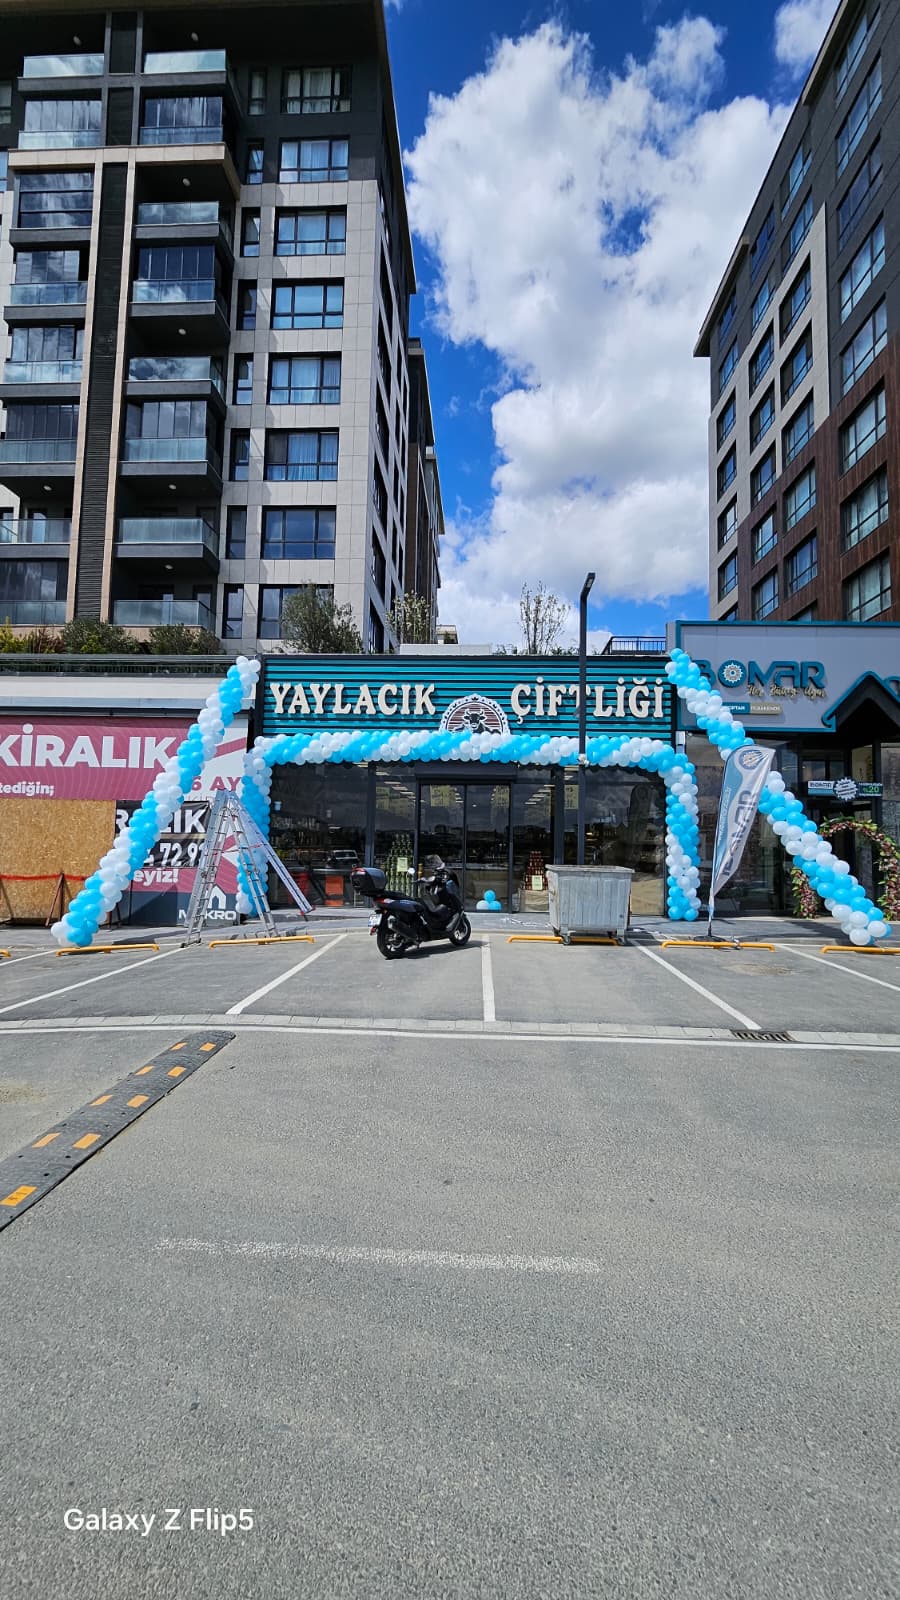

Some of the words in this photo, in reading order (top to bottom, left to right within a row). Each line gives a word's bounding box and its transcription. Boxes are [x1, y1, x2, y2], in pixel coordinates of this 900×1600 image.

[269, 682, 436, 716] YAYLACIK
[510, 676, 664, 724] ÇİFTLİĞİ
[0, 723, 177, 769] KİRALIK
[178, 909, 237, 921] MKRO
